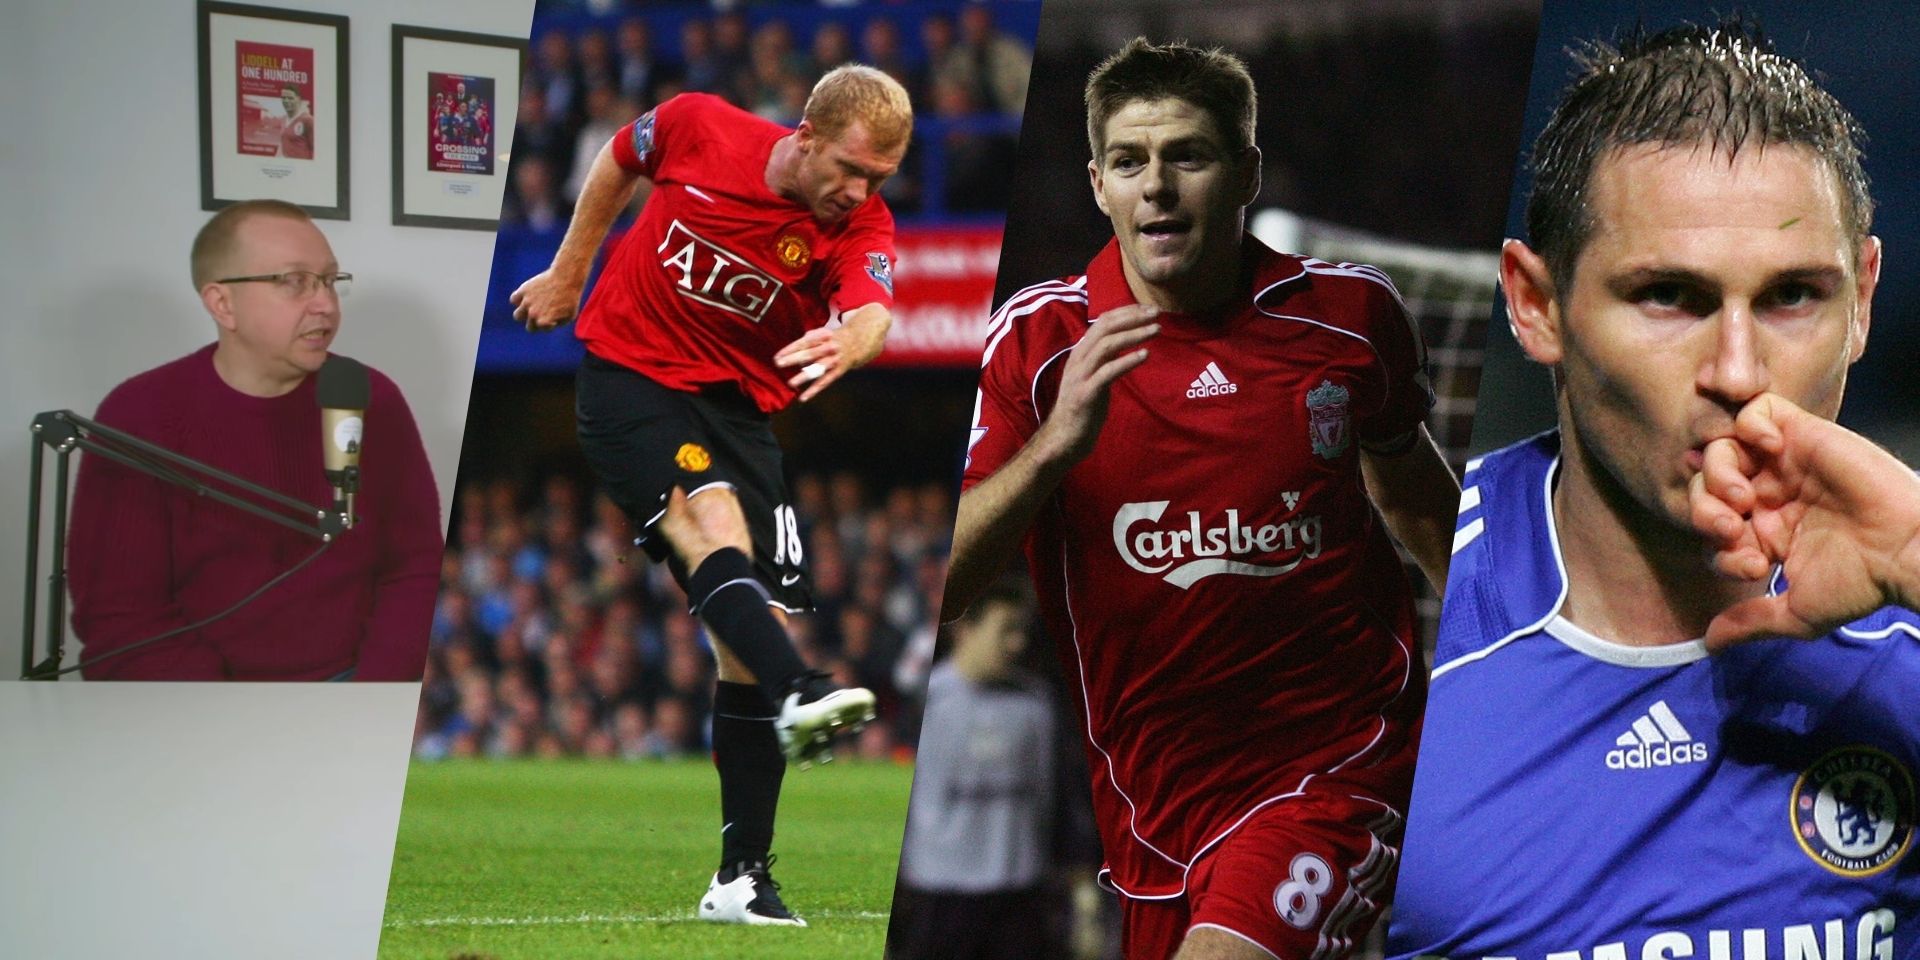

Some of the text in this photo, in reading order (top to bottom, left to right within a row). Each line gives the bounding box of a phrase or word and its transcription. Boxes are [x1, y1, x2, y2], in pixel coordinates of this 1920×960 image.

[241, 53, 294, 70] LIDDELL AT
[241, 66, 308, 84] ONE HUNDRED
[435, 143, 488, 155] CROSSING
[663, 241, 768, 312] AIG
[1186, 383, 1237, 399] adidas
[773, 503, 803, 566] 18
[1113, 500, 1322, 590] Carlsberg
[1605, 741, 1708, 769] adidas
[1821, 842, 1900, 870] FOOTBALL CLUB
[1273, 851, 1335, 931] 8
